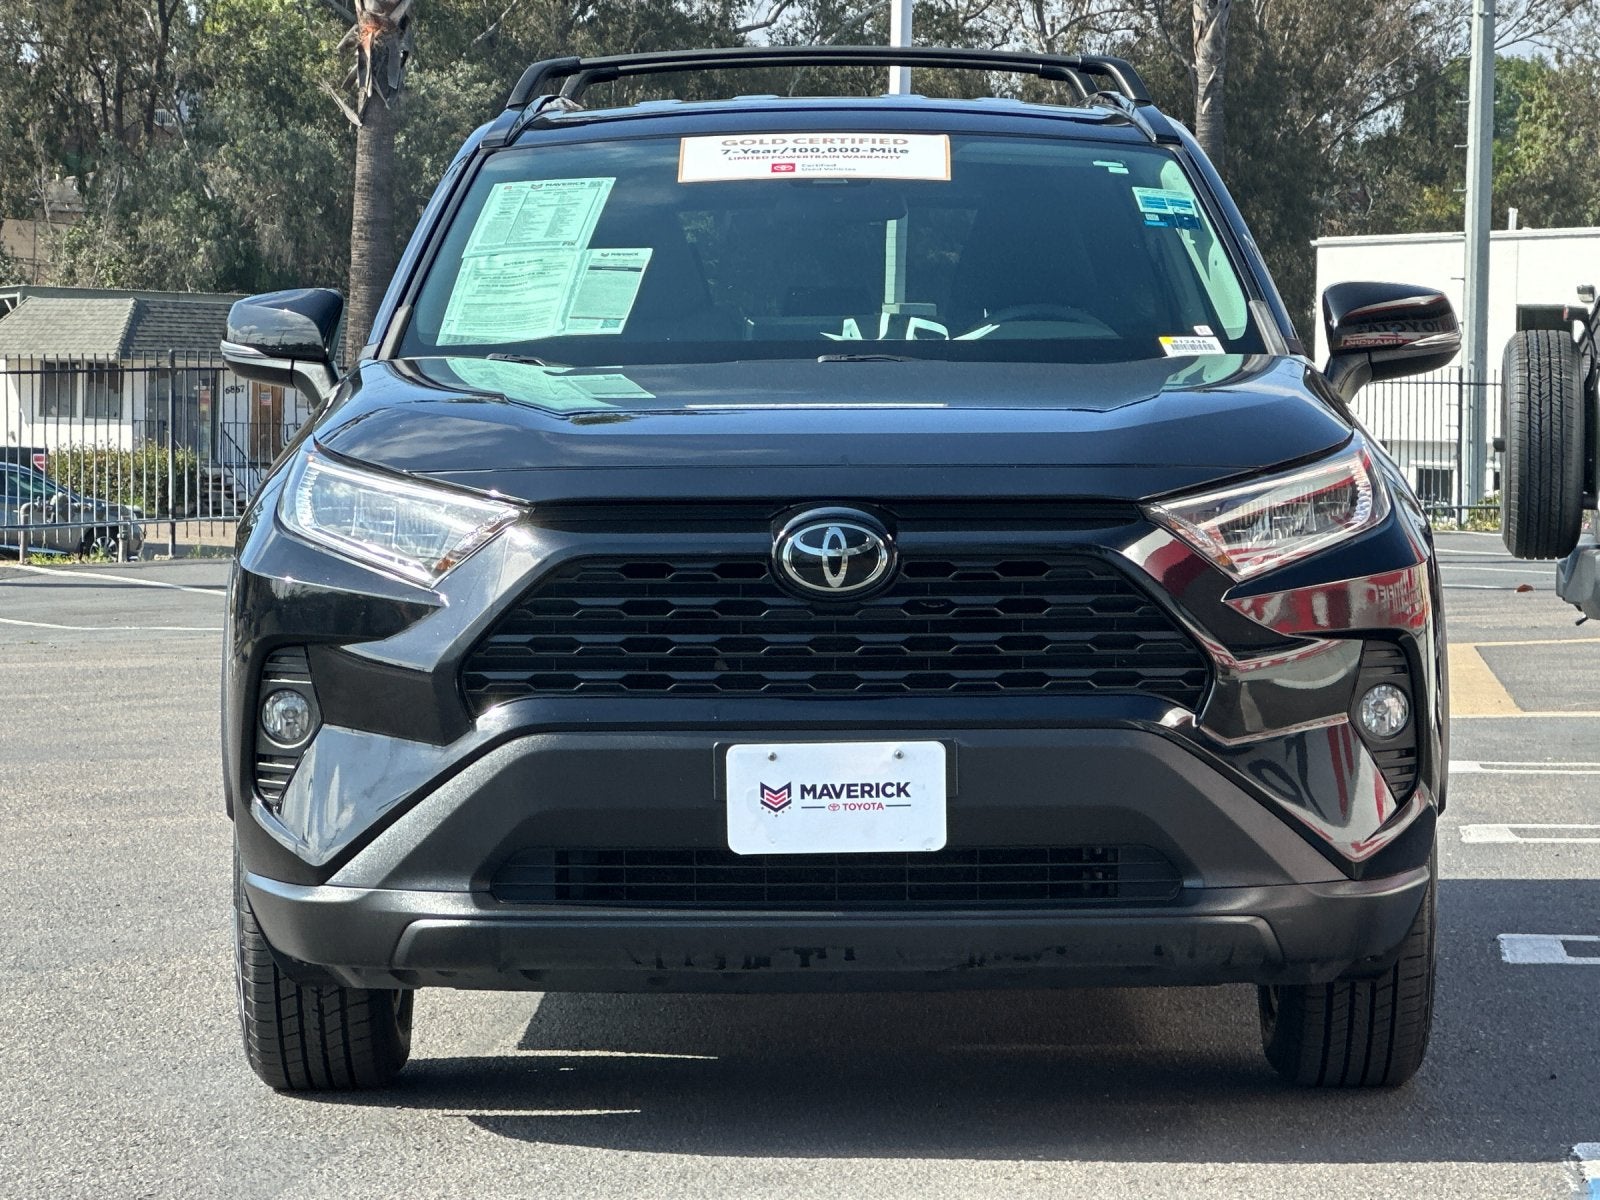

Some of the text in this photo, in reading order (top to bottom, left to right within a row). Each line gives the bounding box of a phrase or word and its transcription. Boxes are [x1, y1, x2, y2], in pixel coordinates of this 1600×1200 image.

[721, 137, 909, 147] GOLD CERTIFIED
[721, 147, 910, 155] 7-Year/100,000-Mile
[799, 781, 912, 800] MAVERICK
[842, 802, 884, 811] TOYOTA
